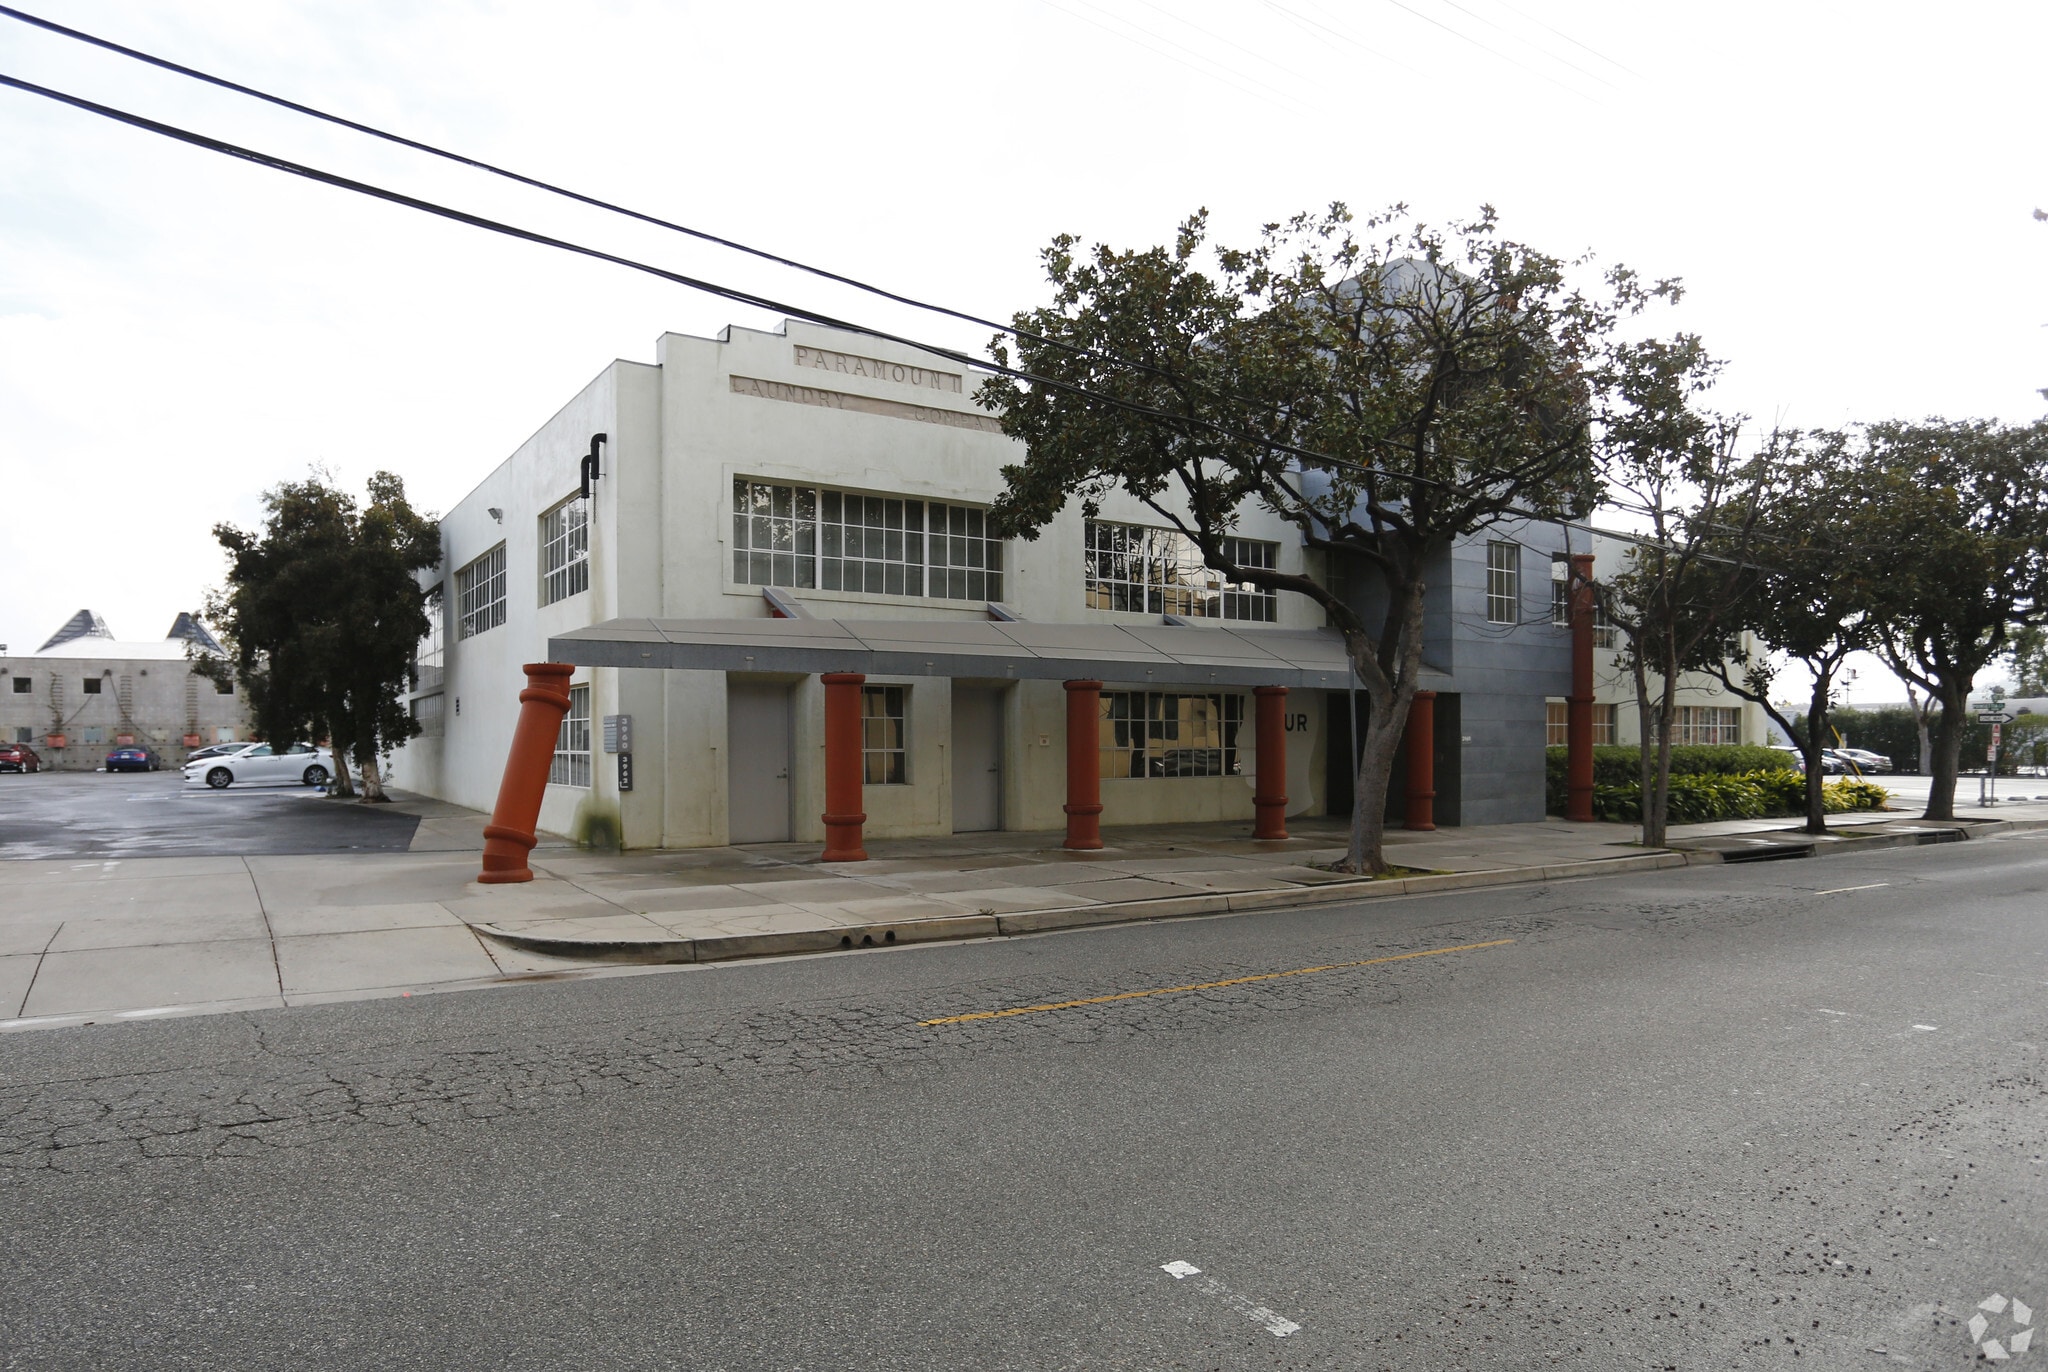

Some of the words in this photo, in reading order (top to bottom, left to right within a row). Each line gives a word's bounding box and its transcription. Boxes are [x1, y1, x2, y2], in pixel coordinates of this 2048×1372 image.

[796, 347, 962, 393] PARAMOUNT
[733, 376, 845, 409] LAUNDRY
[914, 406, 1003, 432] COMPAN
